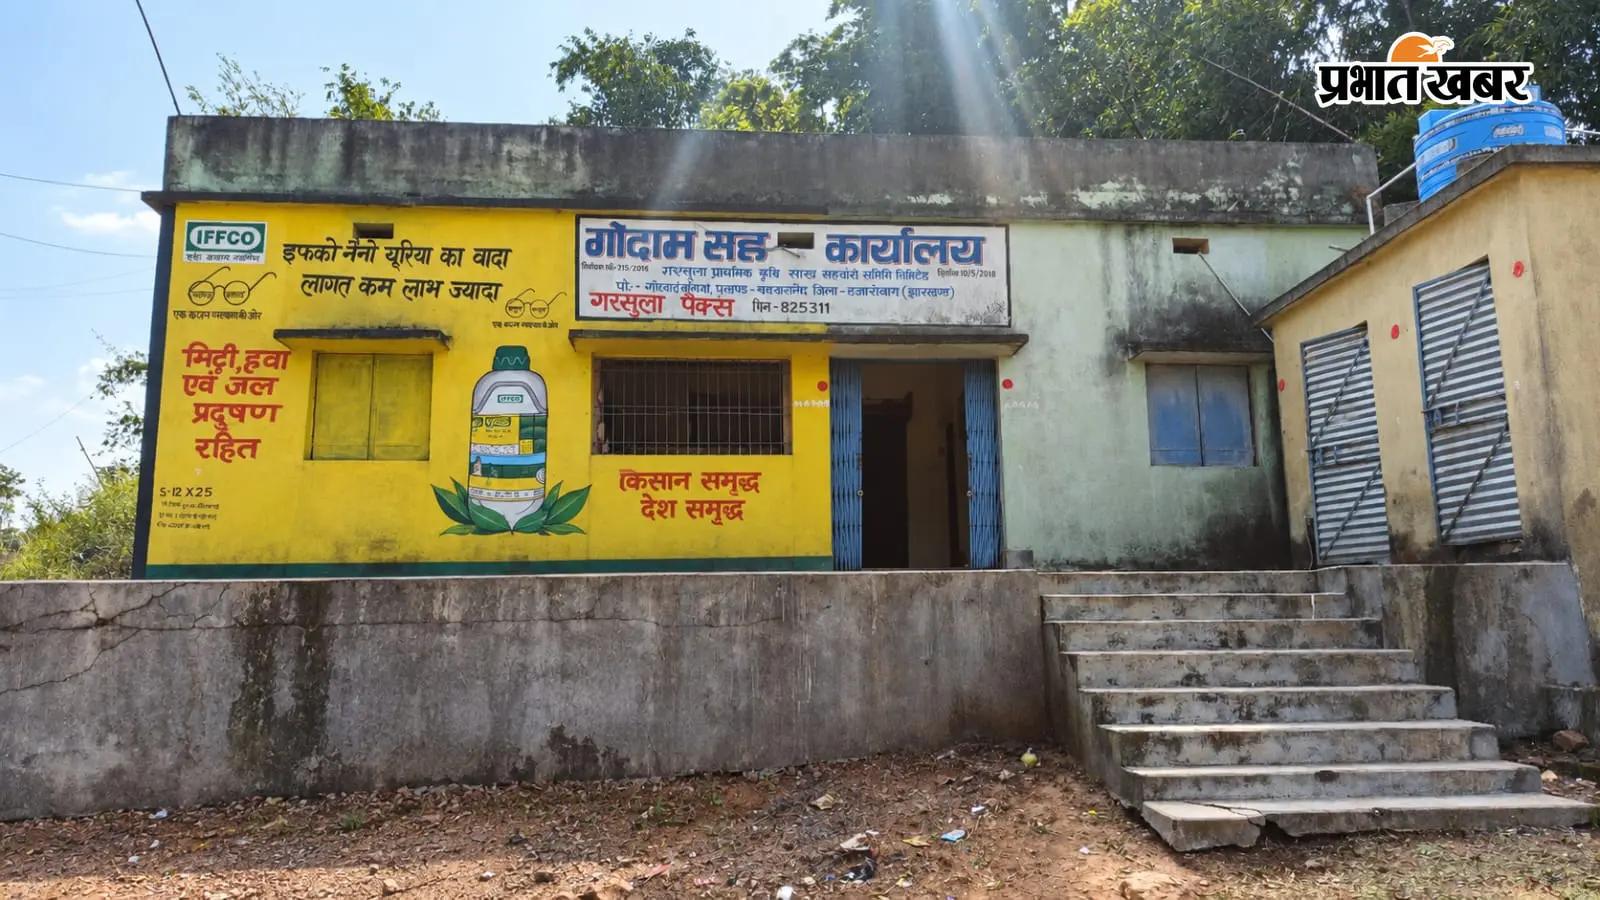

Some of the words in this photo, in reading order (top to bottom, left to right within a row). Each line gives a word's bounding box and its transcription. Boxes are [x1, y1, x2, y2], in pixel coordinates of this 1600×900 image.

[196, 229, 255, 246] IFFCO
[585, 221, 699, 262] गोदाम
[704, 230, 772, 262] सह
[825, 227, 985, 265] कार्यालय
[283, 237, 343, 264] इफको
[384, 239, 433, 271] यूरिया
[439, 246, 465, 267] का
[472, 247, 513, 270] वादा
[301, 274, 355, 298] लागत
[359, 277, 396, 297] कम
[402, 278, 444, 301] लाभ
[448, 281, 504, 303] ज्यादा
[589, 292, 666, 318] गरसुला
[680, 291, 735, 317] पैक्स
[780, 301, 830, 314] 825311
[182, 370, 218, 397] एवं
[225, 376, 280, 396] जल
[195, 431, 262, 463] रहित
[619, 469, 692, 491] किसान
[640, 493, 678, 520] देश
